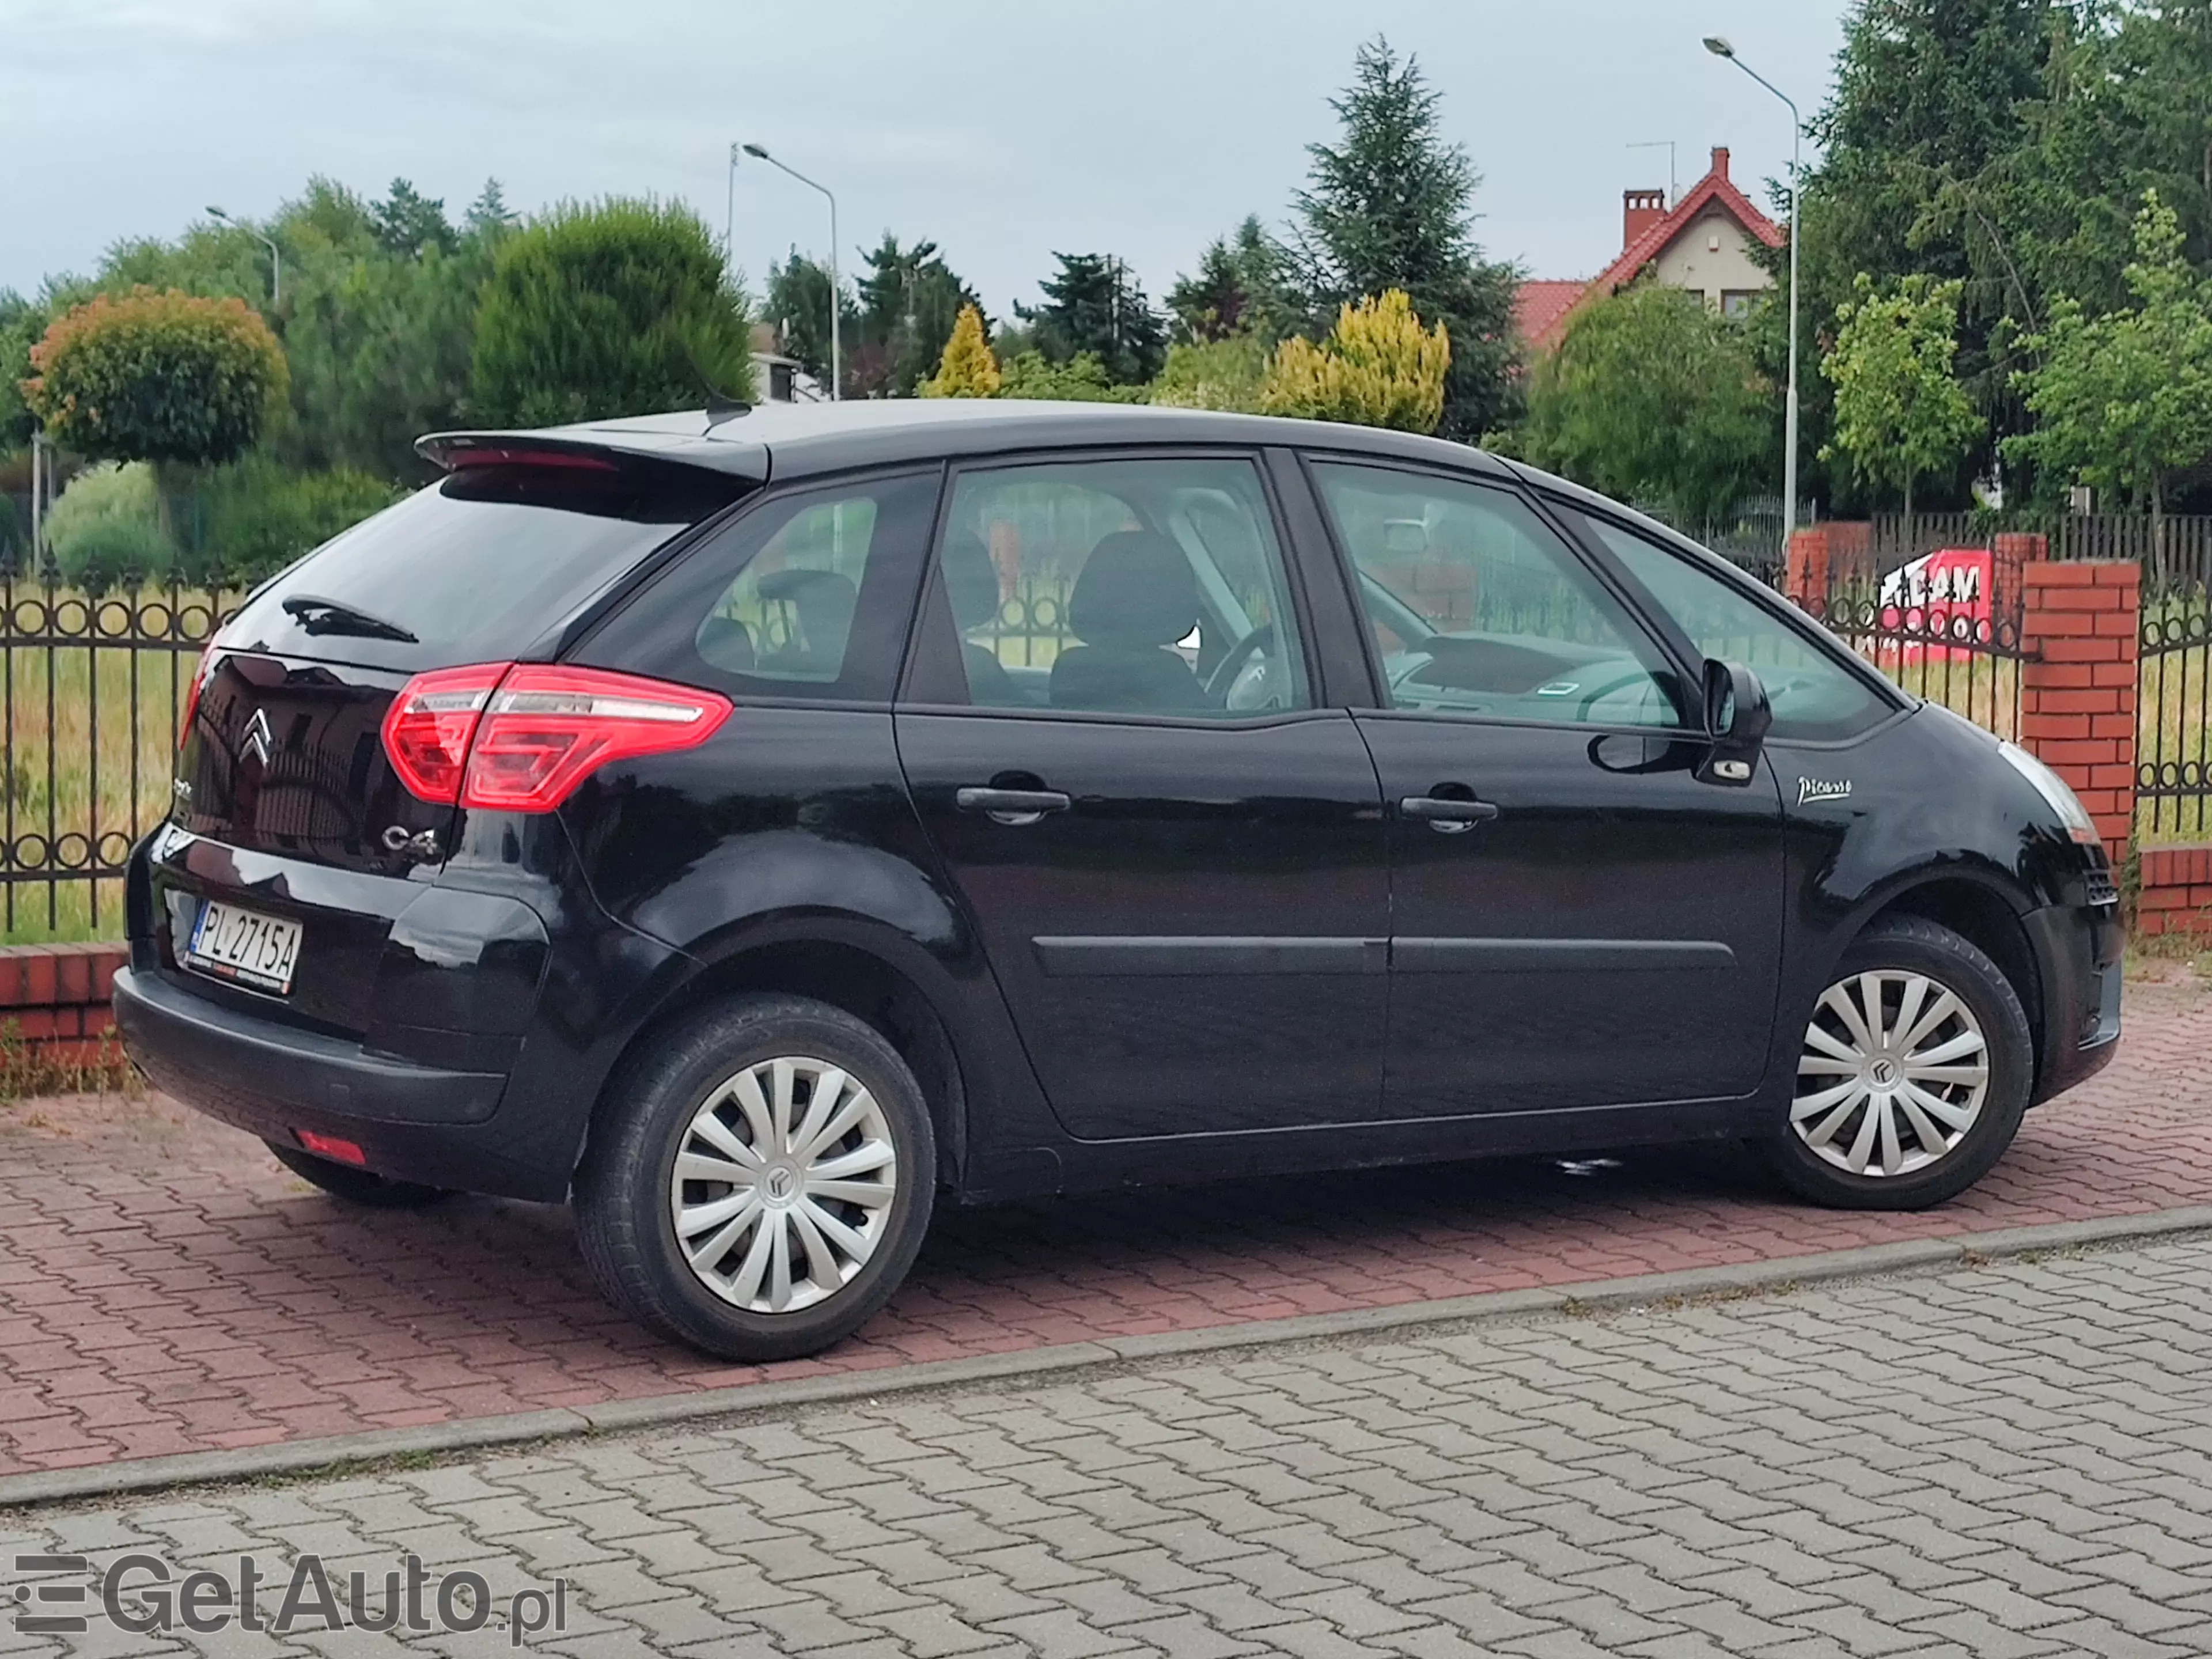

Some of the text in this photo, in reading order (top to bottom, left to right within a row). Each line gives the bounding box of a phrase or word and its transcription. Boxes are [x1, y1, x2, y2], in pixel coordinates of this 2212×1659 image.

[1797, 777, 1853, 806] Picasso
[382, 825, 437, 855] C4
[200, 906, 225, 955] PL
[229, 915, 296, 976] 2715A
